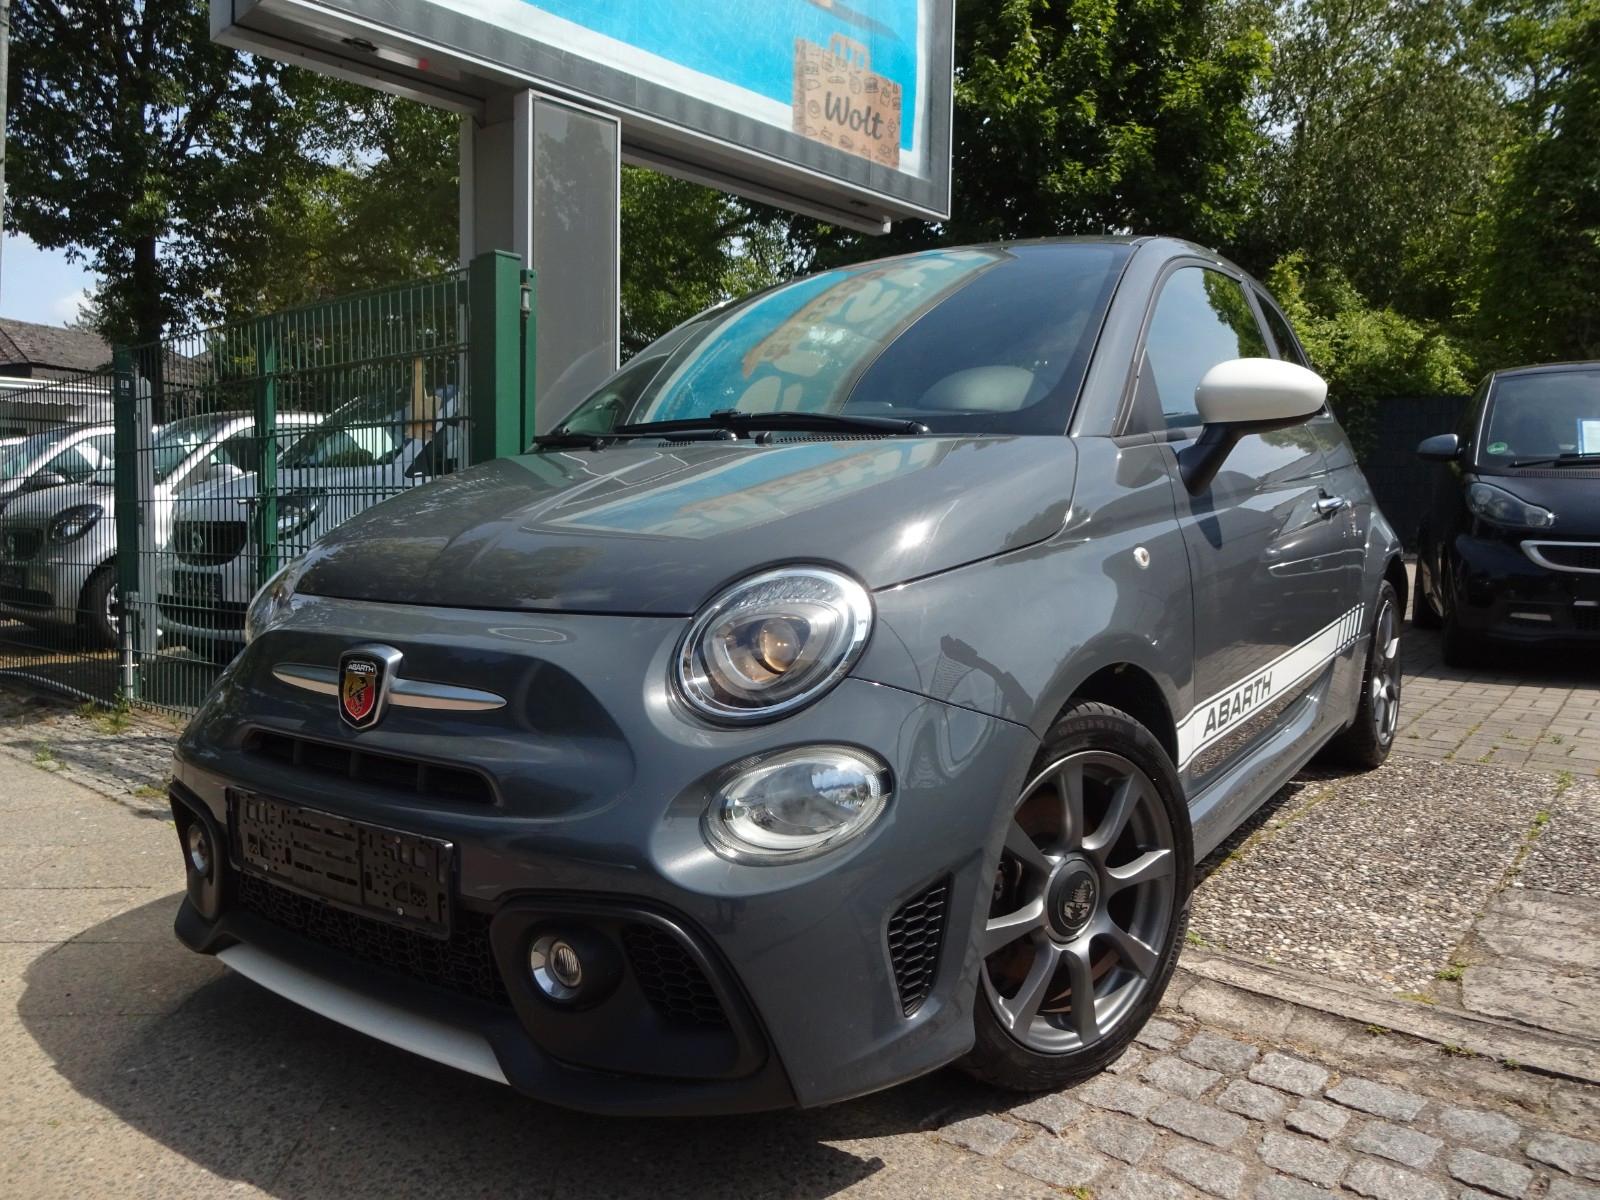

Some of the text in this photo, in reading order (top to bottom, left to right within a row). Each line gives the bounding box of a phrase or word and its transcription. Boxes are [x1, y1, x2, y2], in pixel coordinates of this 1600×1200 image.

[824, 91, 884, 140] Wolt
[348, 663, 374, 672] ABARTH
[1202, 671, 1272, 738] ABARTH
